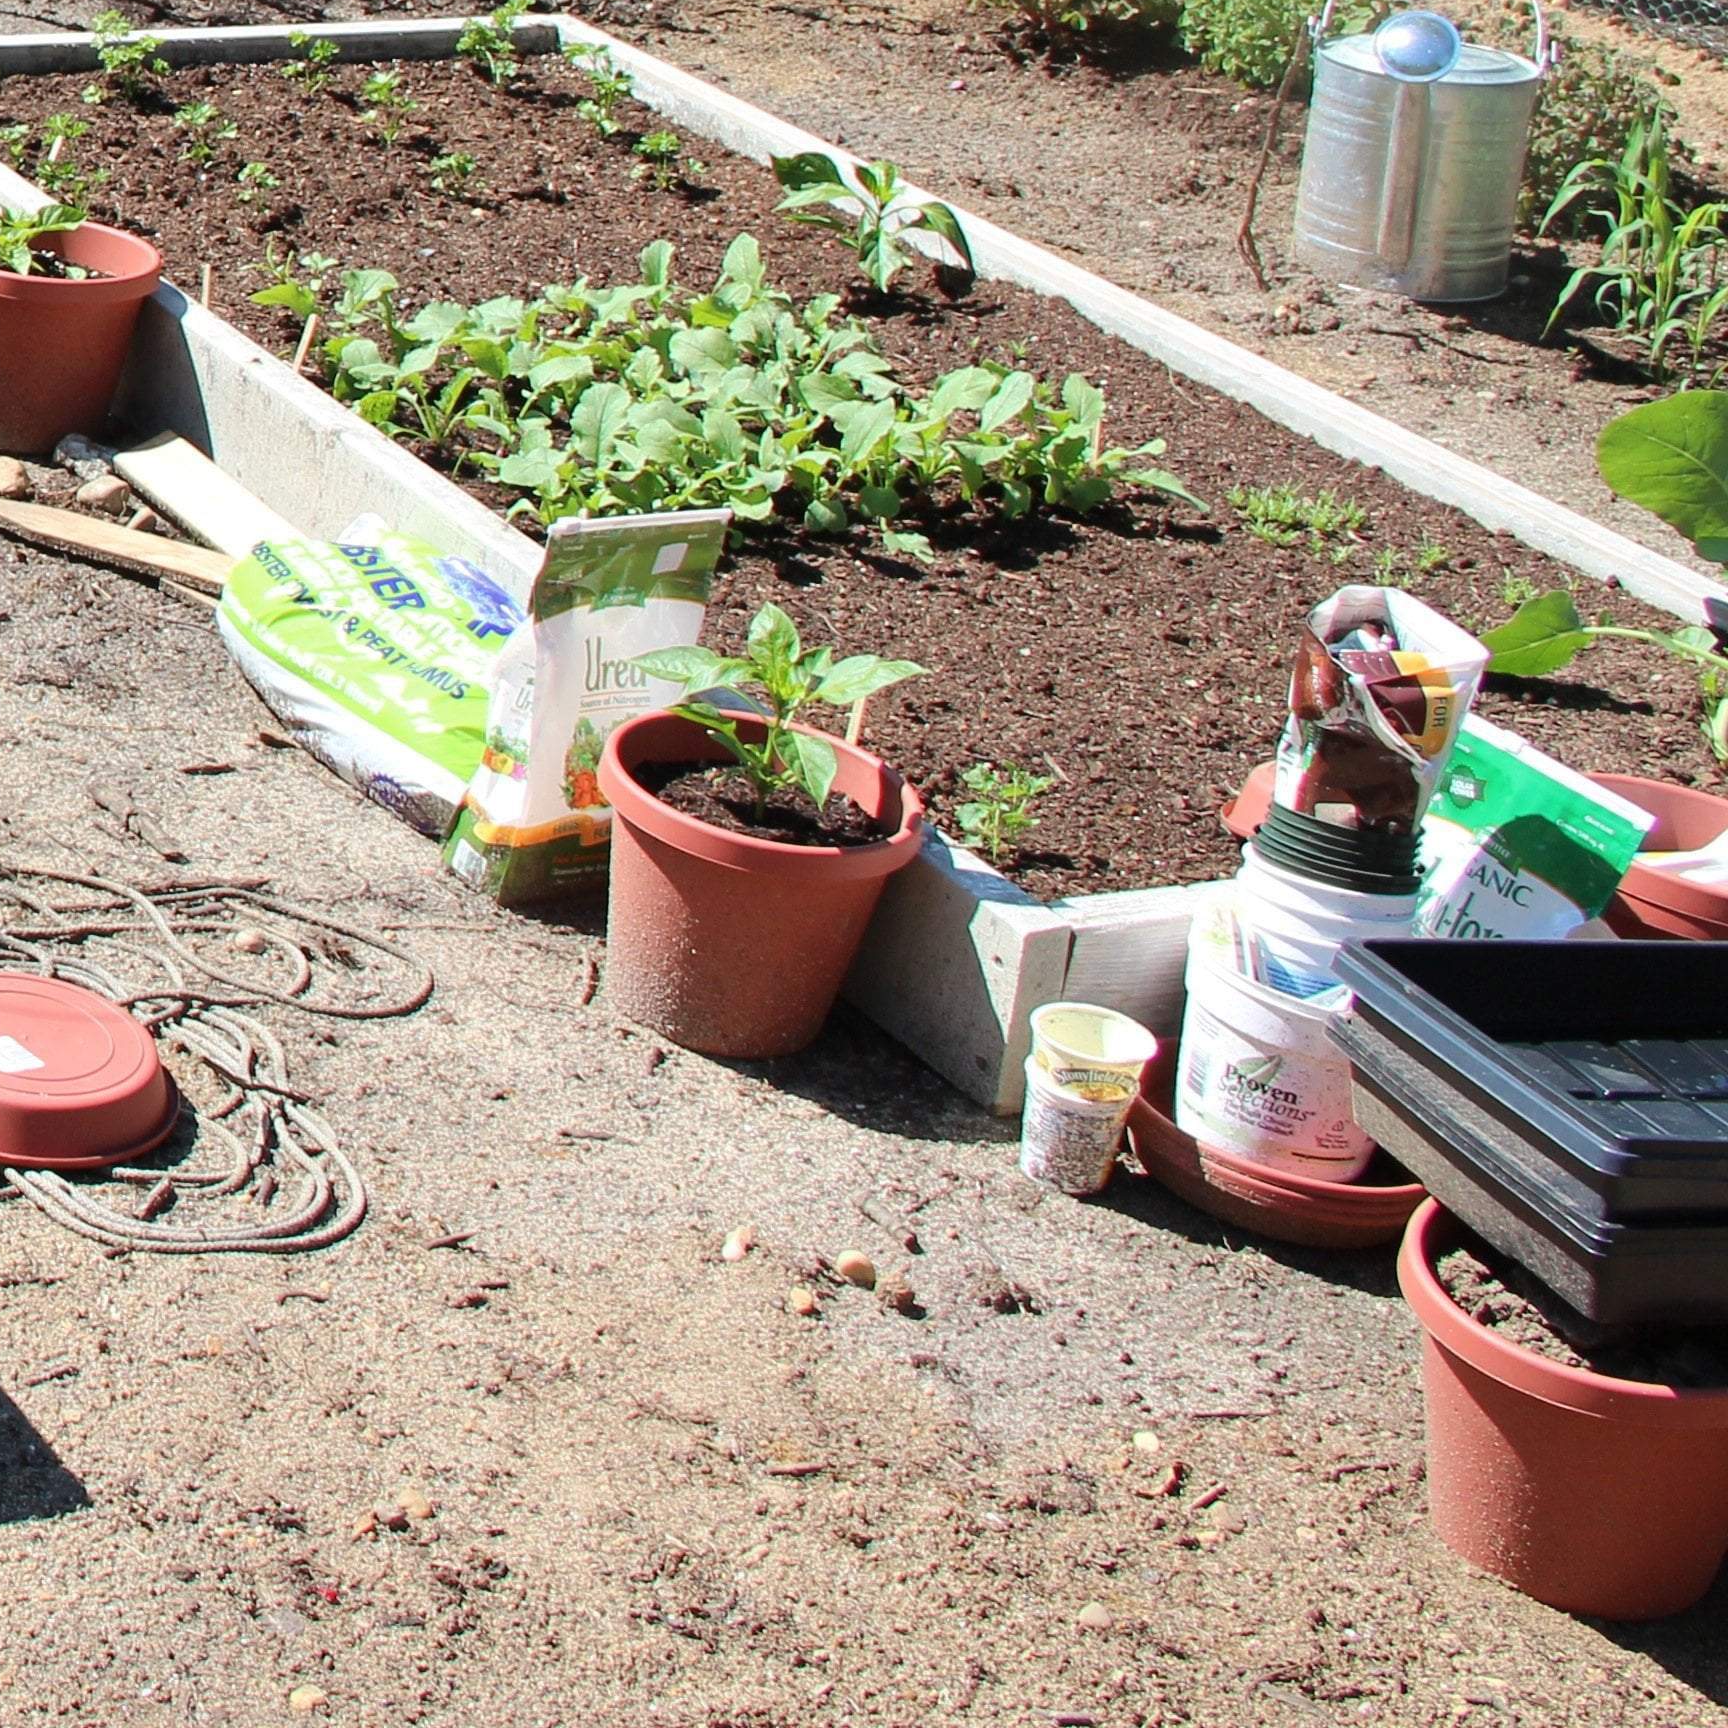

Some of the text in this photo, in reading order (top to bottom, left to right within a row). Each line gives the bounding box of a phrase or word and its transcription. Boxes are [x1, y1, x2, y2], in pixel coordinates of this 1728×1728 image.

[340, 544, 426, 610] BSTER
[343, 616, 360, 635] &
[356, 628, 408, 665] PEAT
[1432, 696, 1447, 728] FOR
[1225, 1063, 1299, 1105] Proven
